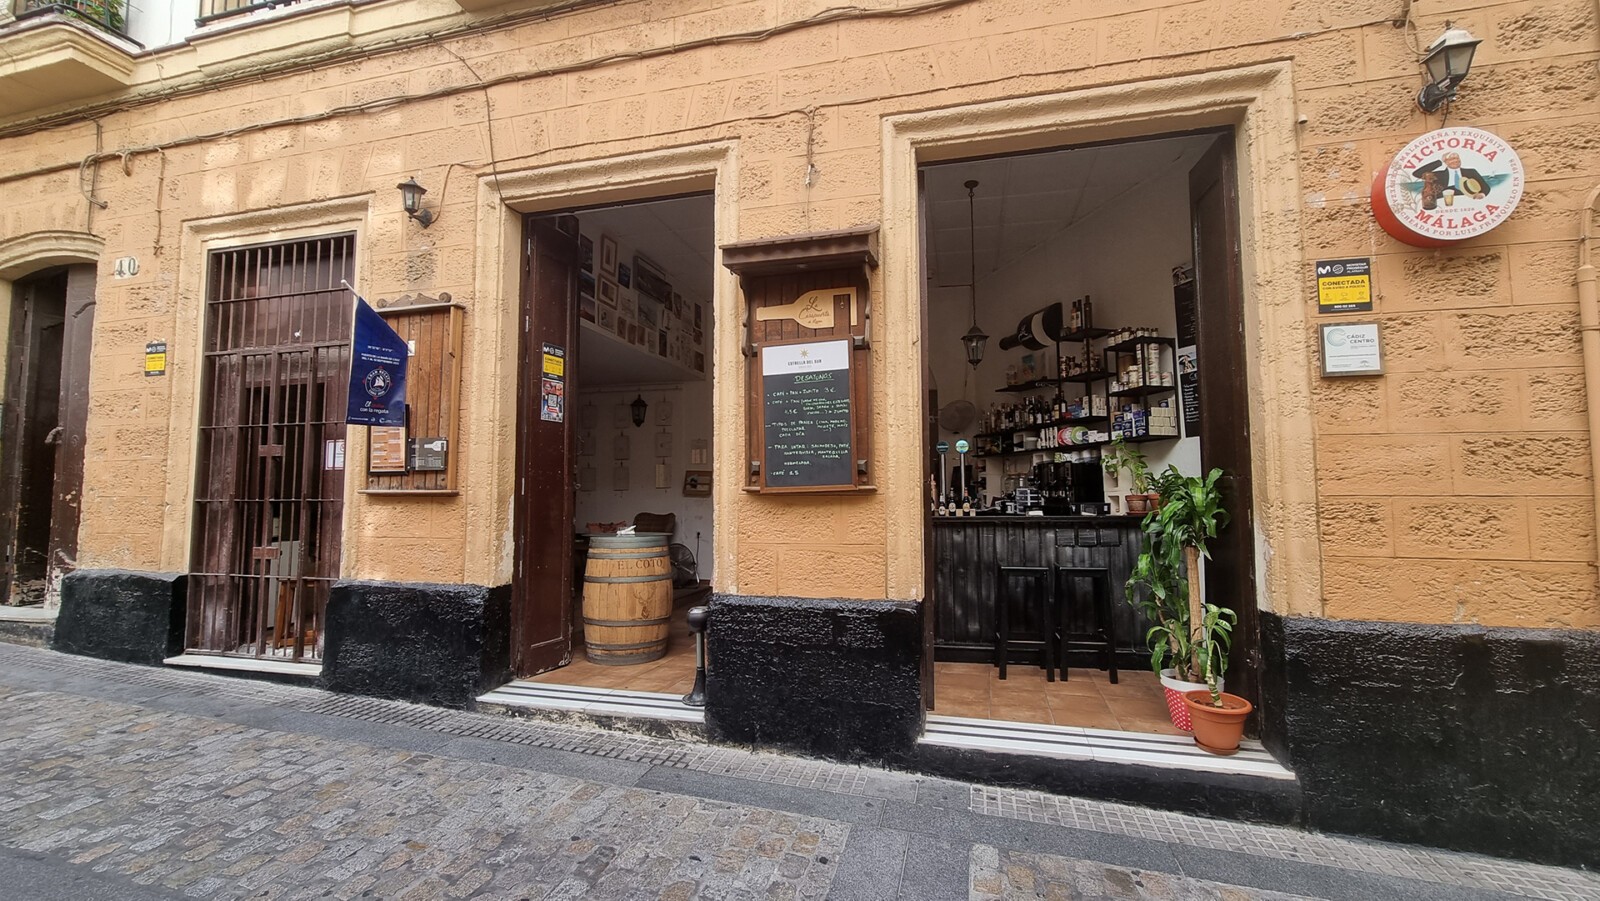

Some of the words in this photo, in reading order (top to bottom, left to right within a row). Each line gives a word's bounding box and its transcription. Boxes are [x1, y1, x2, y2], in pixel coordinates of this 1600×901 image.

[1399, 130, 1449, 162] MALAGUEÑA
[1460, 130, 1506, 153] EXQUISITA
[1403, 137, 1499, 170] VICTORIA
[1414, 203, 1501, 229] MÁLAGA
[1433, 228, 1452, 237] POR
[1455, 226, 1478, 237] LUIS
[1480, 188, 1518, 230] FRANQUELO
[1513, 176, 1520, 187] EN
[1322, 279, 1366, 287] CONECTADA
[617, 560, 632, 570] EL
[635, 558, 663, 569] COTO
